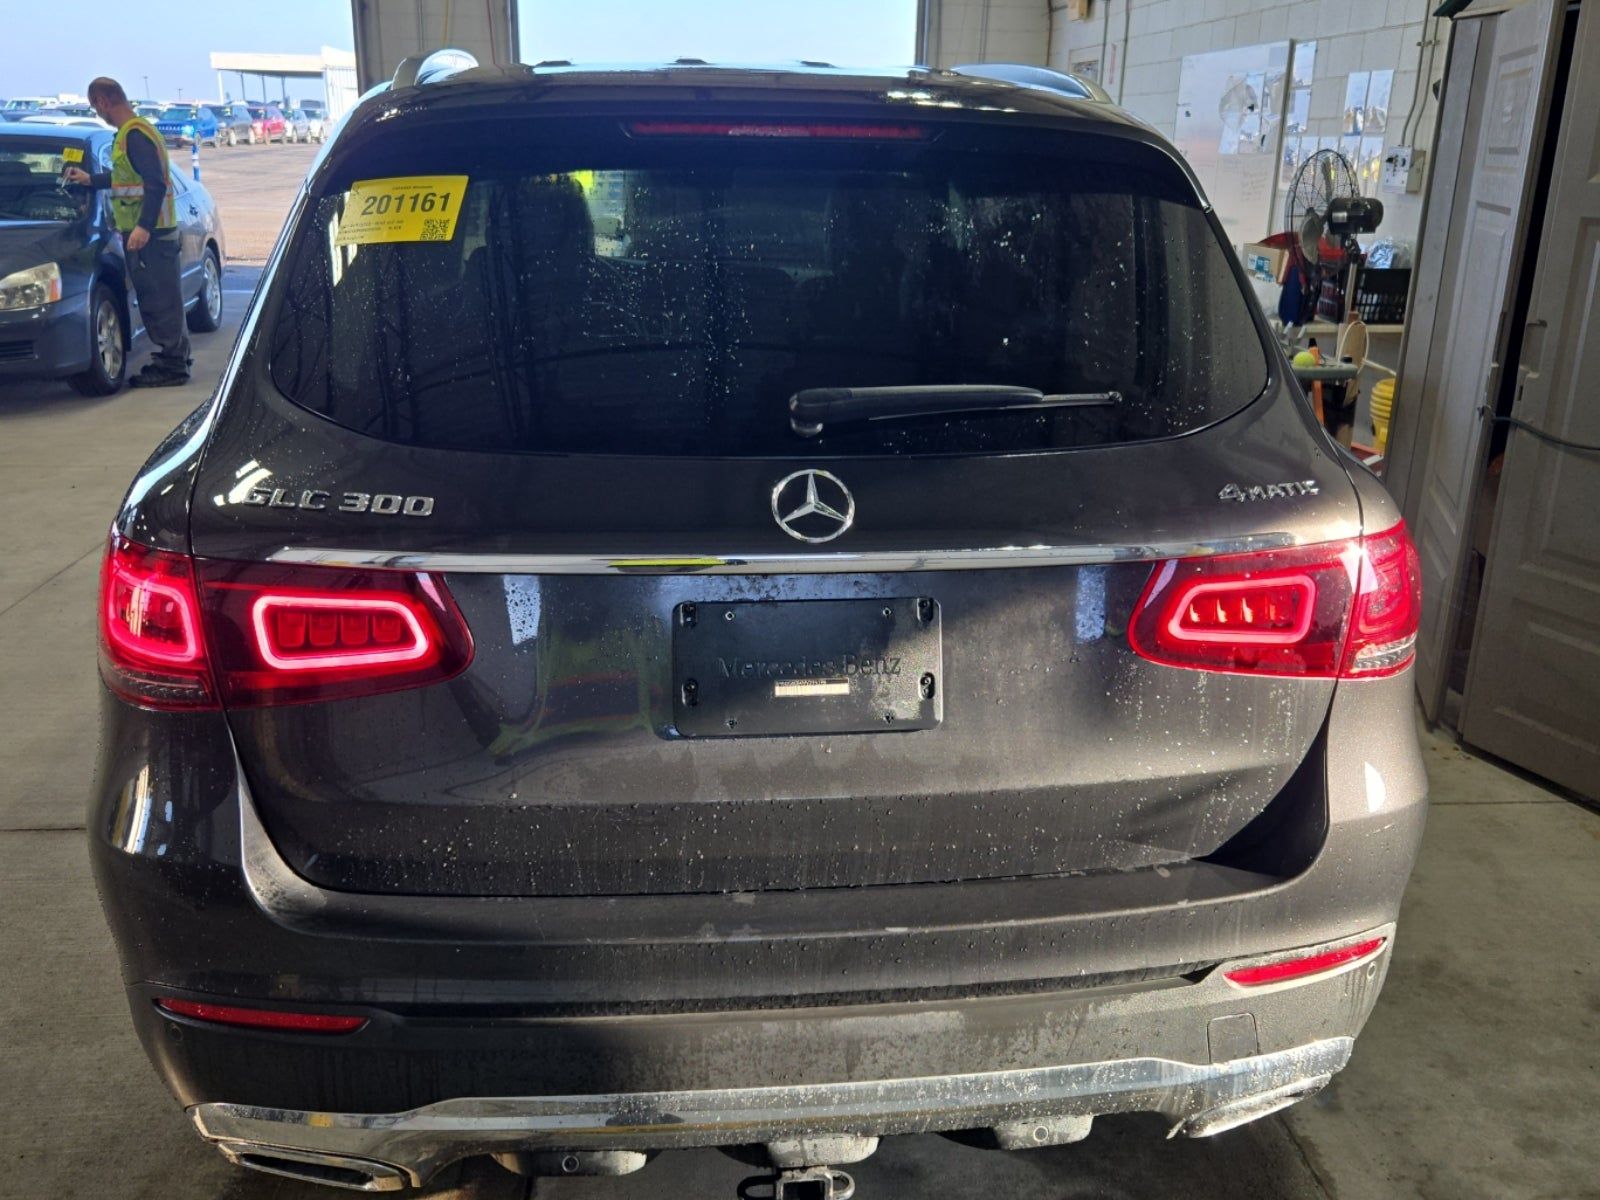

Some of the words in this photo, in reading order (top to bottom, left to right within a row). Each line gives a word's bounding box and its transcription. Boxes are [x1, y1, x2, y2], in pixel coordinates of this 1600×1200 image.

[361, 192, 450, 215] 201161
[243, 486, 330, 509] GLC
[339, 491, 435, 516] 300
